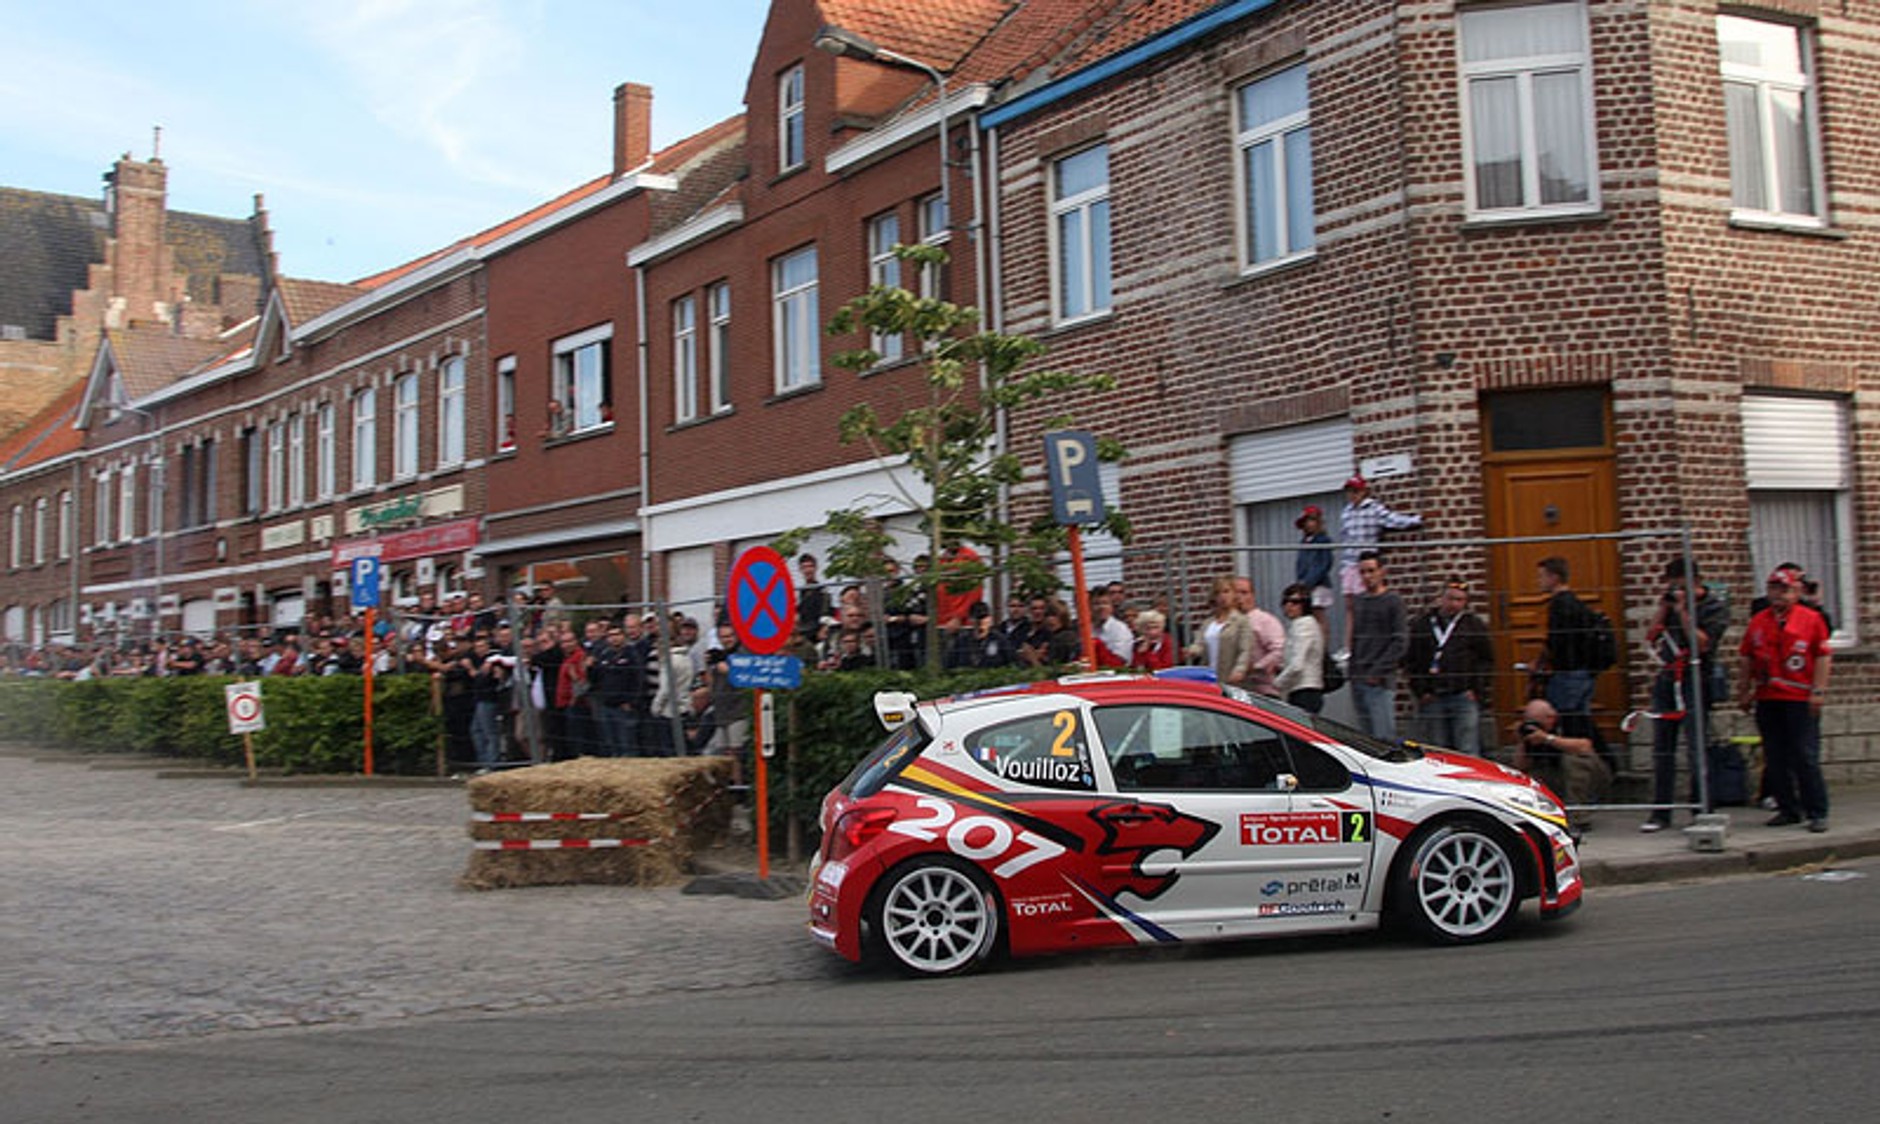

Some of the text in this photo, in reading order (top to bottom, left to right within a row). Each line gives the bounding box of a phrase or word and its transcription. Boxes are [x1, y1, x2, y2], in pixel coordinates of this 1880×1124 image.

[1056, 439, 1086, 486] P
[356, 559, 373, 585] P
[1051, 710, 1076, 757] 2
[996, 755, 1080, 782] Vouilloz
[887, 798, 1067, 879] 207
[1243, 823, 1337, 844] TOTAL
[1350, 813, 1365, 842] 2
[1012, 901, 1073, 916] TOTAL
